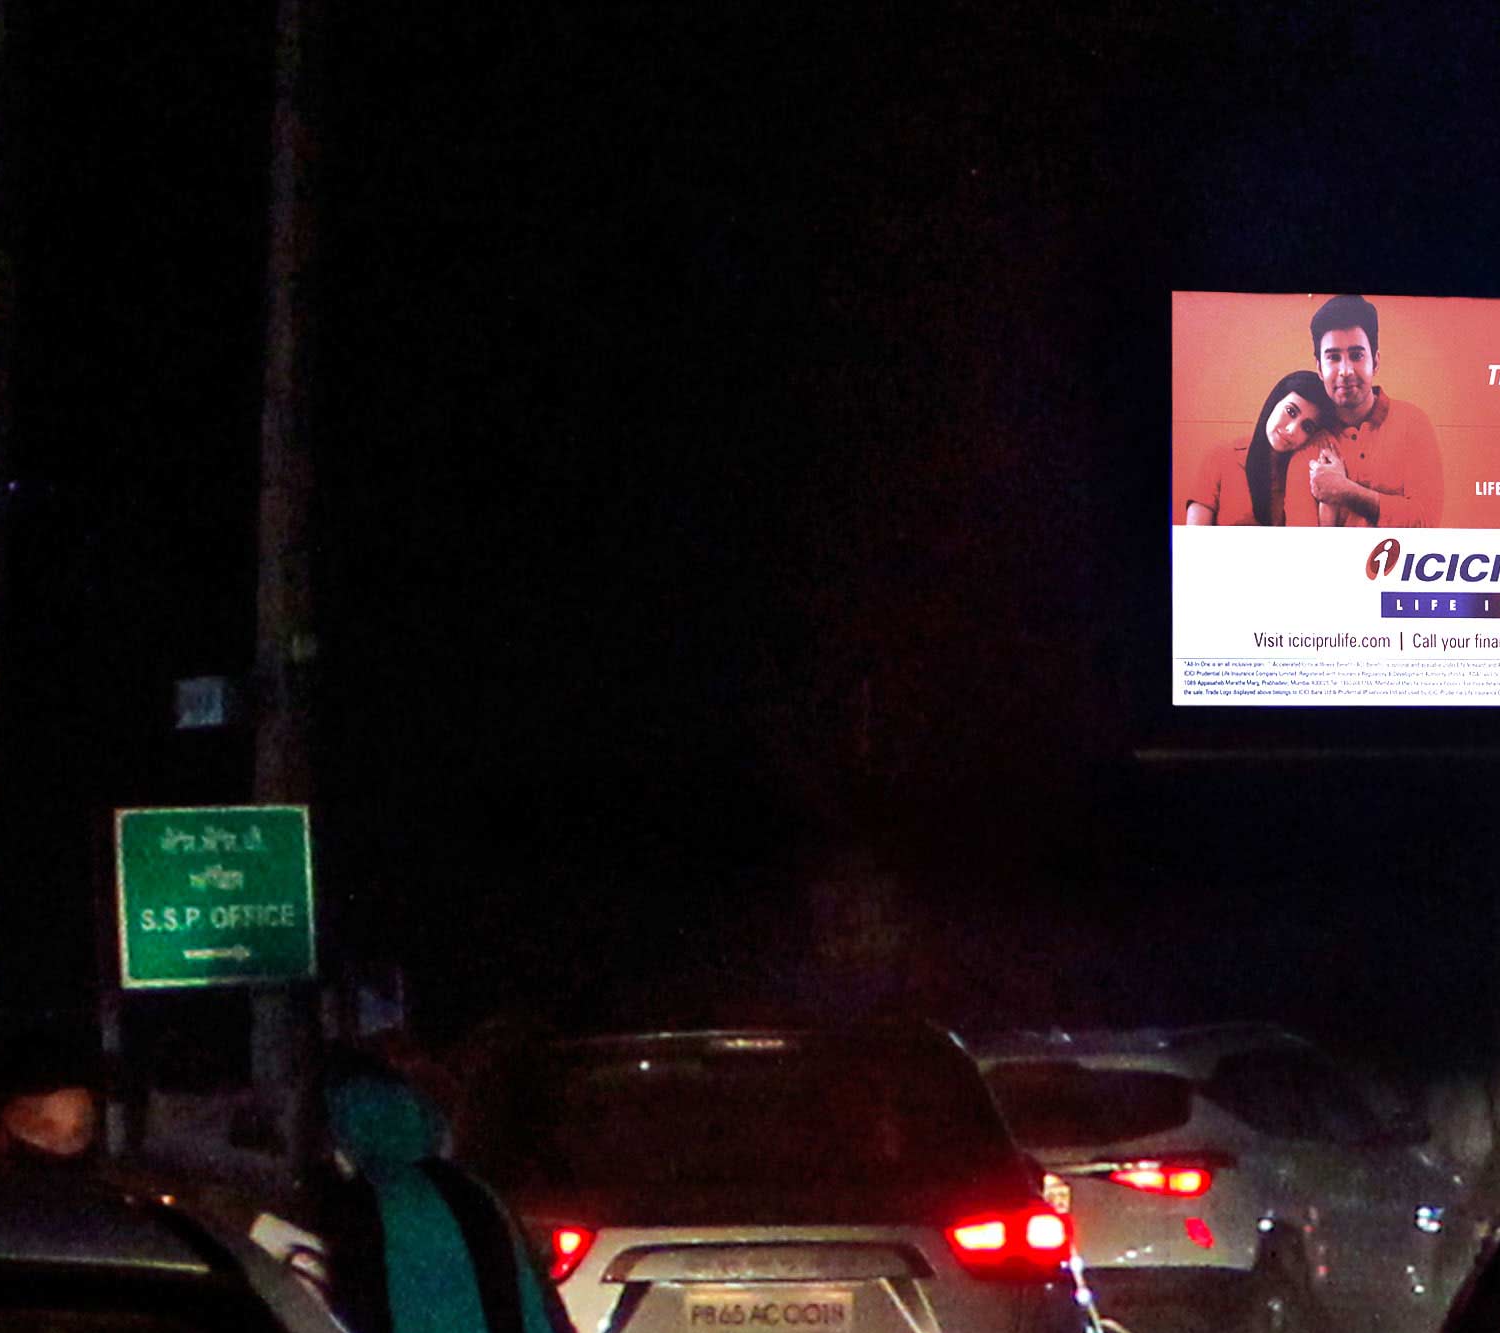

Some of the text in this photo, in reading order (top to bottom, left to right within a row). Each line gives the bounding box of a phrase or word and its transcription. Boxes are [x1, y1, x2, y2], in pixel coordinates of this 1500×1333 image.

[1396, 599, 1457, 611] LIFE
[1254, 632, 1284, 649] Visit
[1288, 632, 1391, 651] iciciprulife.com
[1412, 633, 1438, 649] Call
[1441, 636, 1471, 651] your
[210, 904, 296, 929] OFFICE
